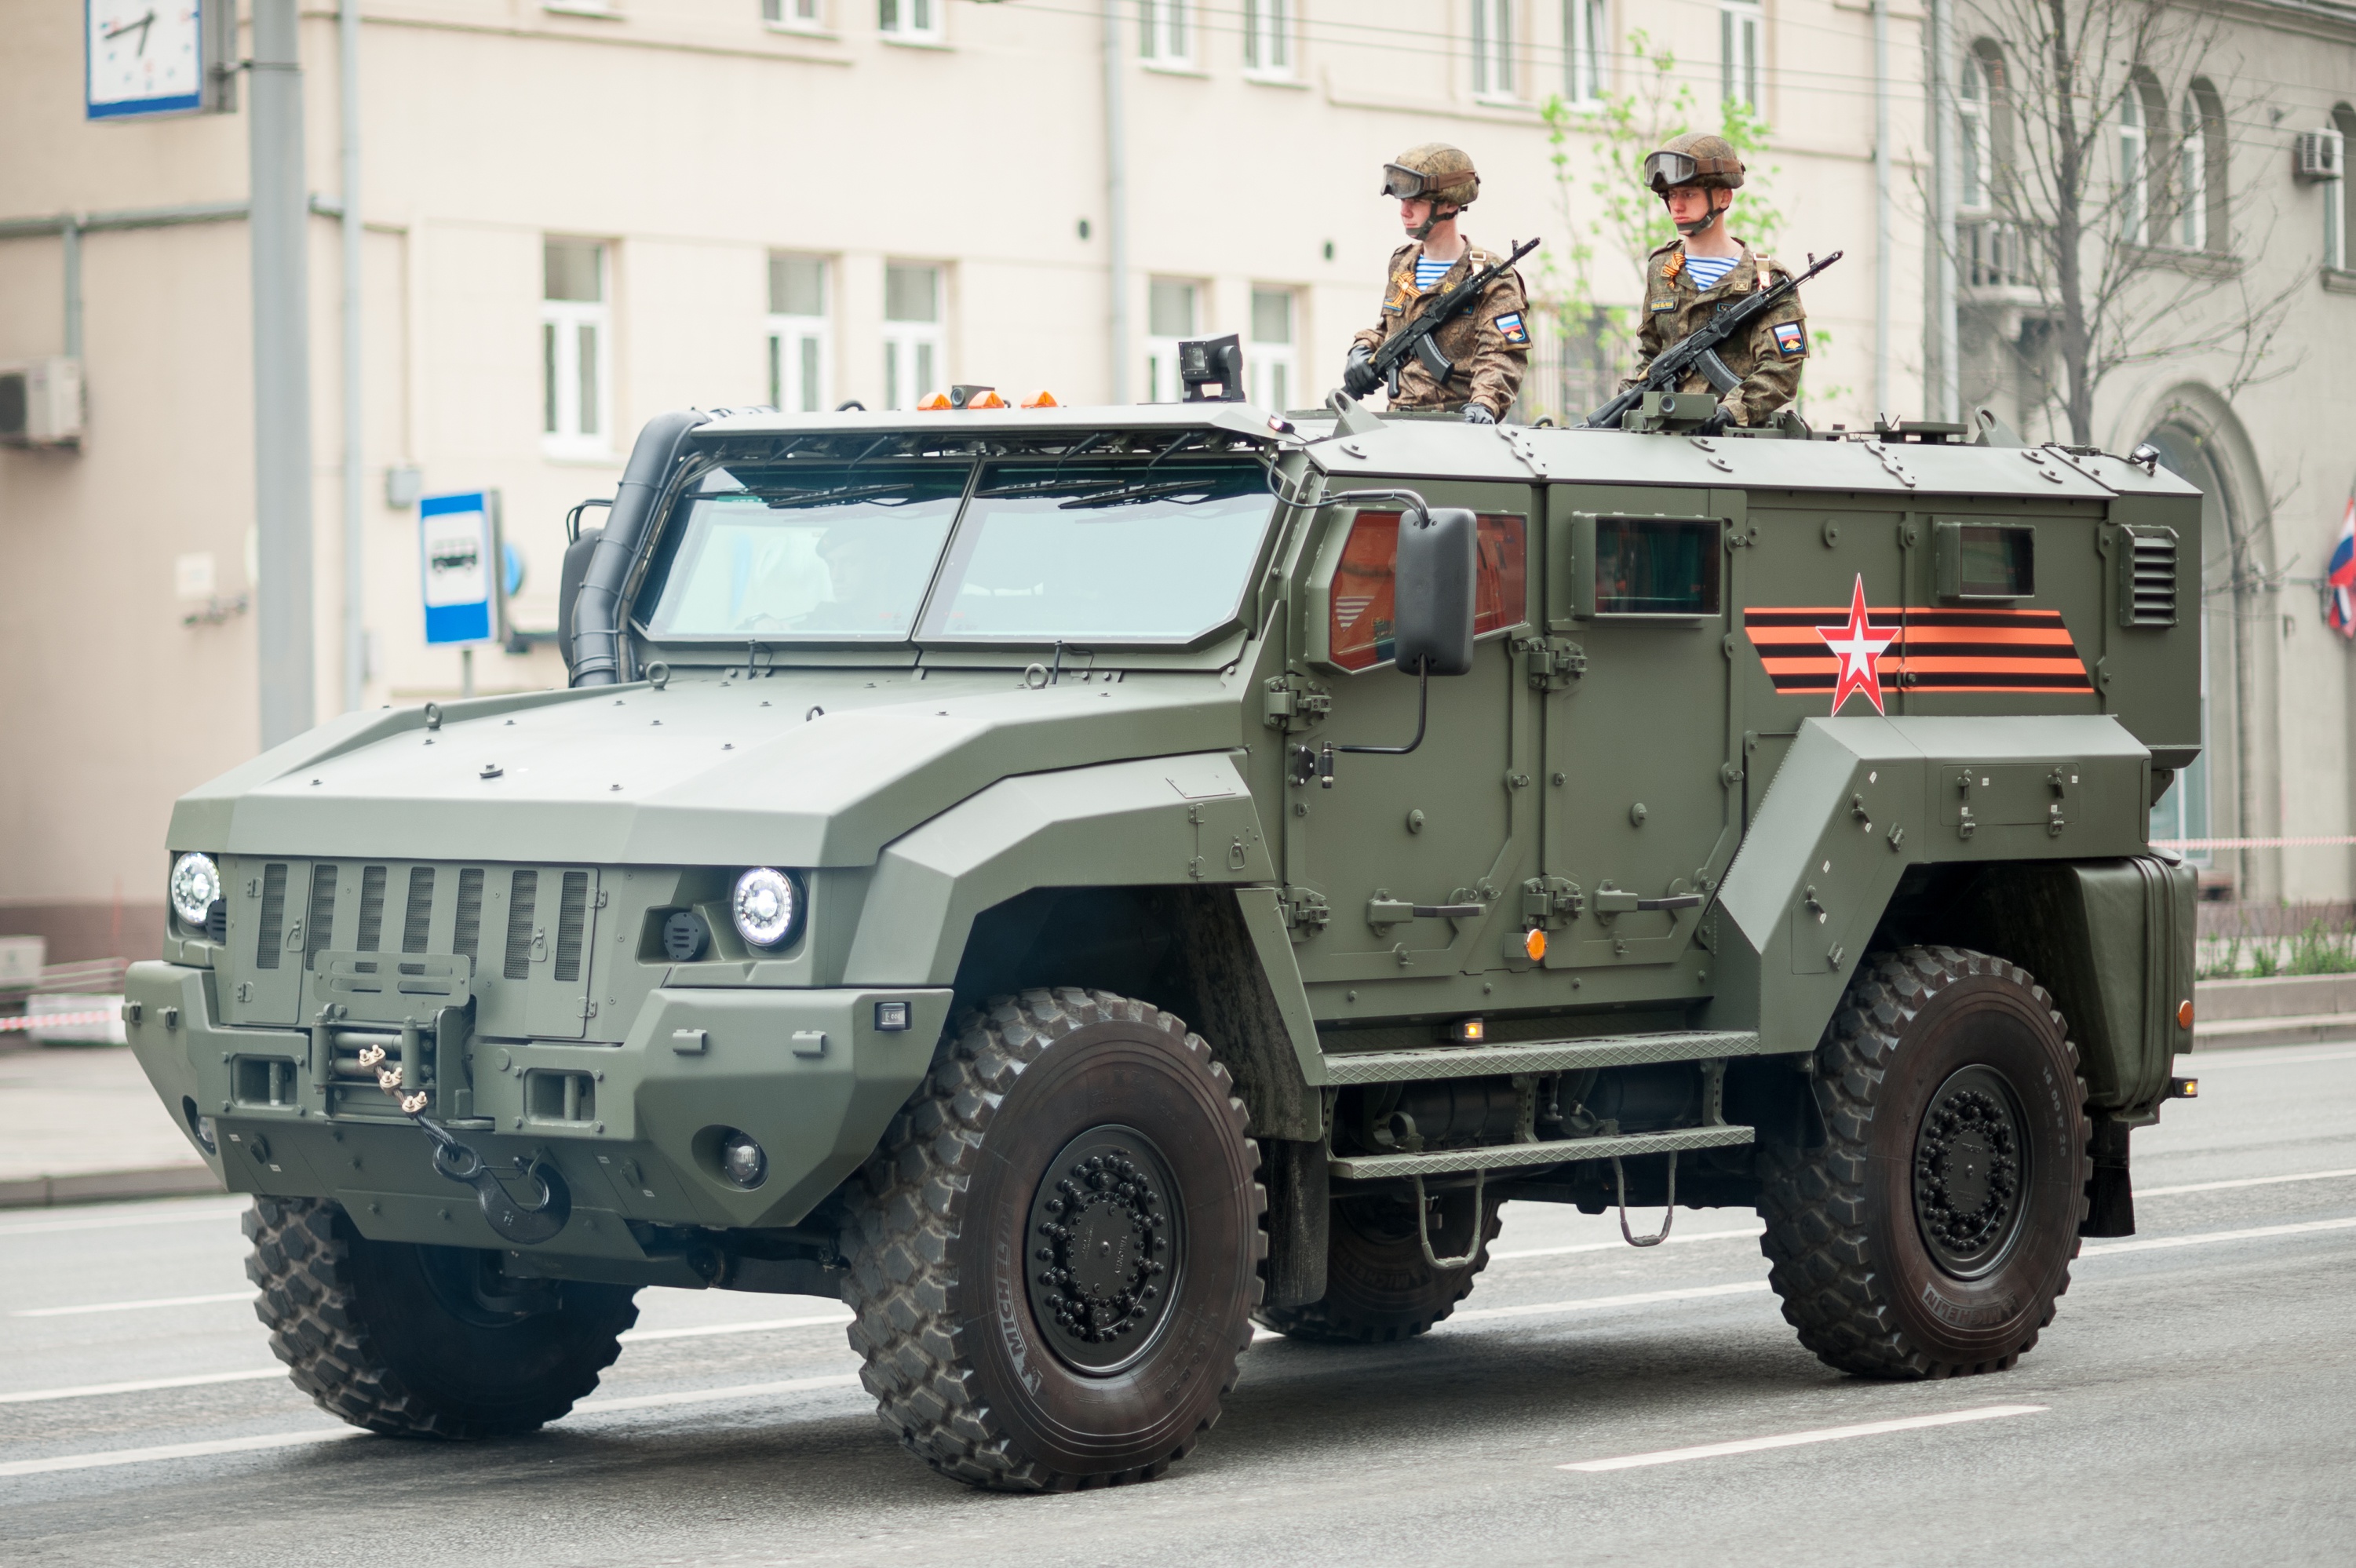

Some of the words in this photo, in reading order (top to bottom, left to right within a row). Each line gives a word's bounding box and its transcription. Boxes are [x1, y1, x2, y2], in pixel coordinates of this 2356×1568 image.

[2057, 1116, 2064, 1129] R
[2059, 1134, 2066, 1157] 20
[995, 1202, 1024, 1358] MICHELIN
[1924, 1289, 2001, 1326] MICHELIN
[1180, 1366, 1191, 1381] R
[1164, 1381, 1181, 1399] 20
